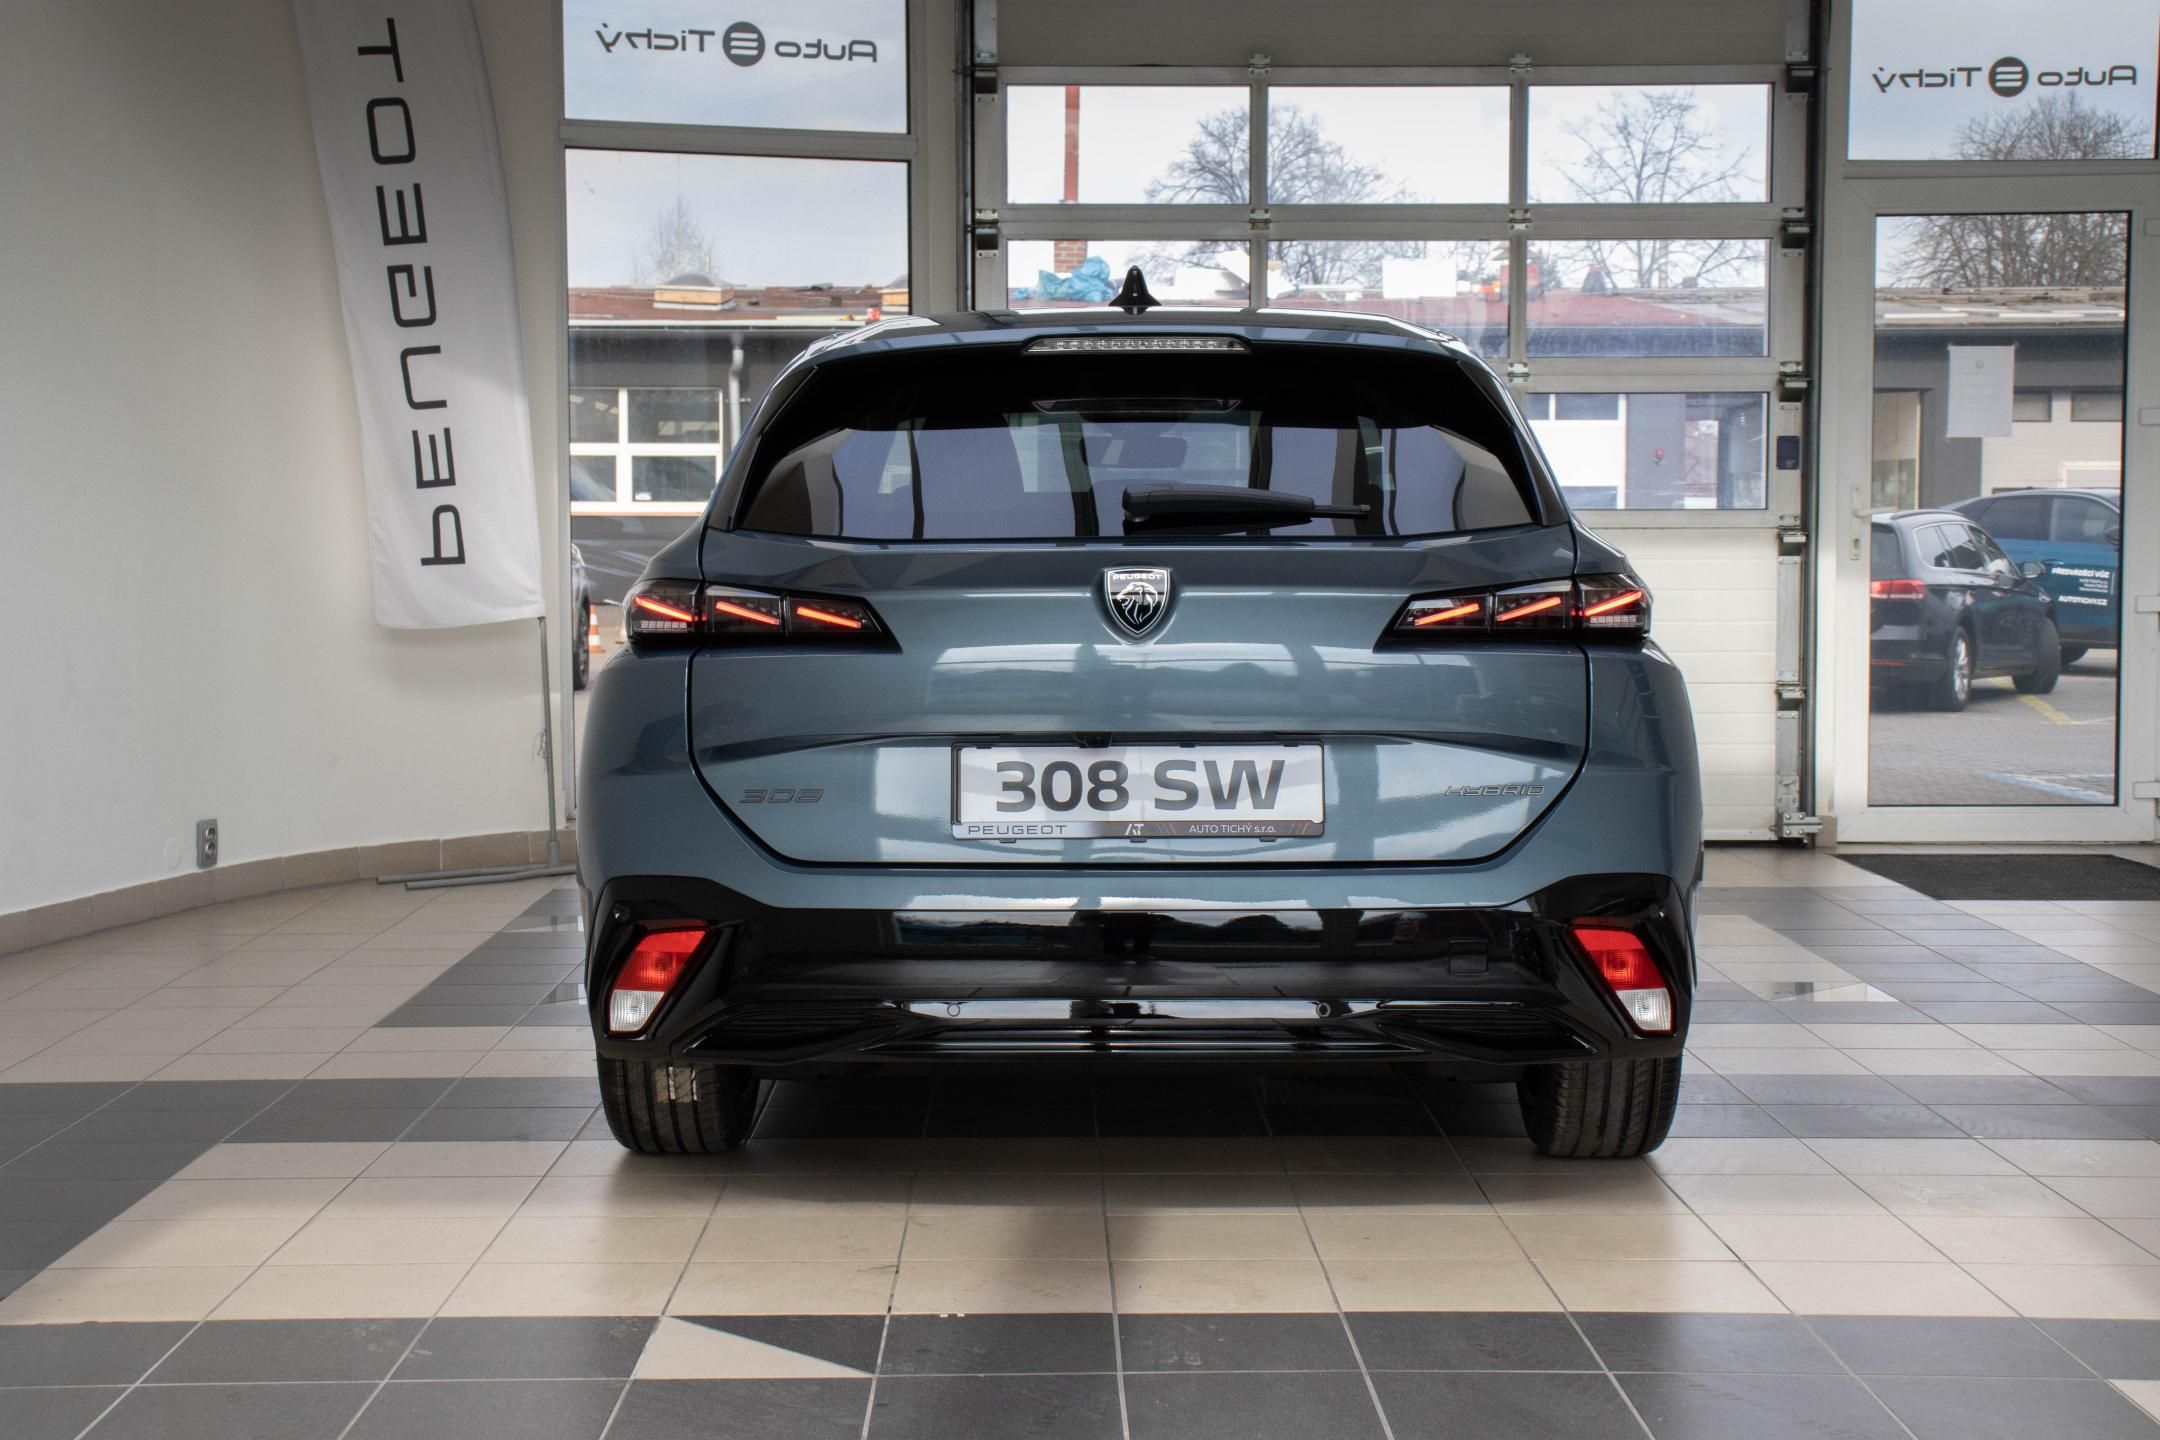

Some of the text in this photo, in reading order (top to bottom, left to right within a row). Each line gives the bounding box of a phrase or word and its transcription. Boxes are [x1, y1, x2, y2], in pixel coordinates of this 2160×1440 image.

[995, 758, 1286, 813] 308 SW
[1444, 784, 1545, 797] HYBRID
[739, 788, 824, 804] 308
[967, 824, 1068, 836] PEUGEOT
[1188, 822, 1277, 834] AUTO TICHÝ s.r.o.
